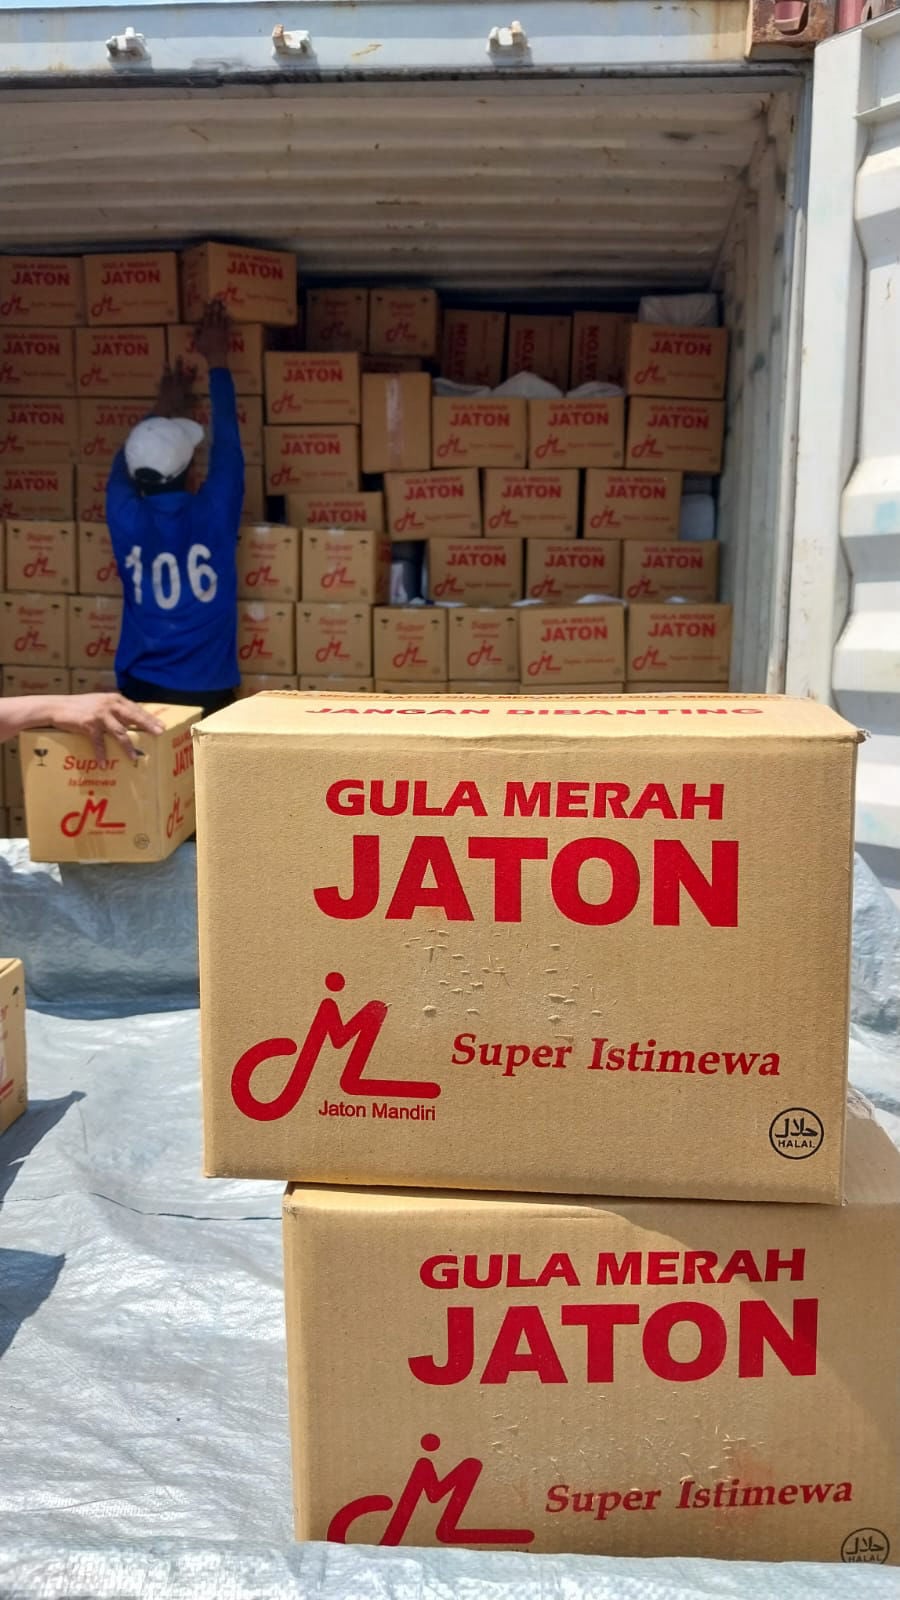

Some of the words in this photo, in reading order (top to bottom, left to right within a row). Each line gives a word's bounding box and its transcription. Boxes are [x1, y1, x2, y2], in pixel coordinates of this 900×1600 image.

[101, 270, 160, 285] JATON
[227, 261, 284, 280] JATON
[11, 271, 71, 286] JATON
[4, 341, 60, 356] JATON
[91, 342, 149, 356] JATON
[650, 340, 712, 356] JATON
[283, 368, 343, 383] JATON
[7, 411, 65, 425] JATON
[450, 412, 510, 427] JATON
[548, 411, 609, 426] JATON
[647, 414, 710, 429] JATON
[281, 441, 341, 455] JATON
[3, 478, 58, 491] JATON
[501, 484, 561, 499] JATON
[605, 484, 666, 499] JATON
[405, 484, 464, 501] JATON
[306, 508, 367, 524] JATON
[446, 553, 506, 567] JATON
[545, 554, 605, 569] JATON
[641, 554, 703, 569] JATON
[125, 544, 218, 610] 106
[540, 625, 608, 643] JATON
[648, 622, 717, 639] JATON
[506, 708, 764, 716] DIBANTING
[325, 779, 489, 818] GULA
[502, 782, 725, 821] MERAH
[313, 834, 739, 928] JATON
[451, 1032, 572, 1078] Super
[586, 1037, 782, 1078] Istimewa
[318, 1100, 367, 1118] Jaton
[371, 1102, 436, 1121] Mandiri
[778, 1139, 816, 1149] HALAL
[418, 1252, 581, 1290] GULA
[596, 1248, 806, 1287] MERAH
[408, 1297, 819, 1386] JATON
[544, 1483, 661, 1521] Super
[675, 1479, 854, 1512] Istimewa
